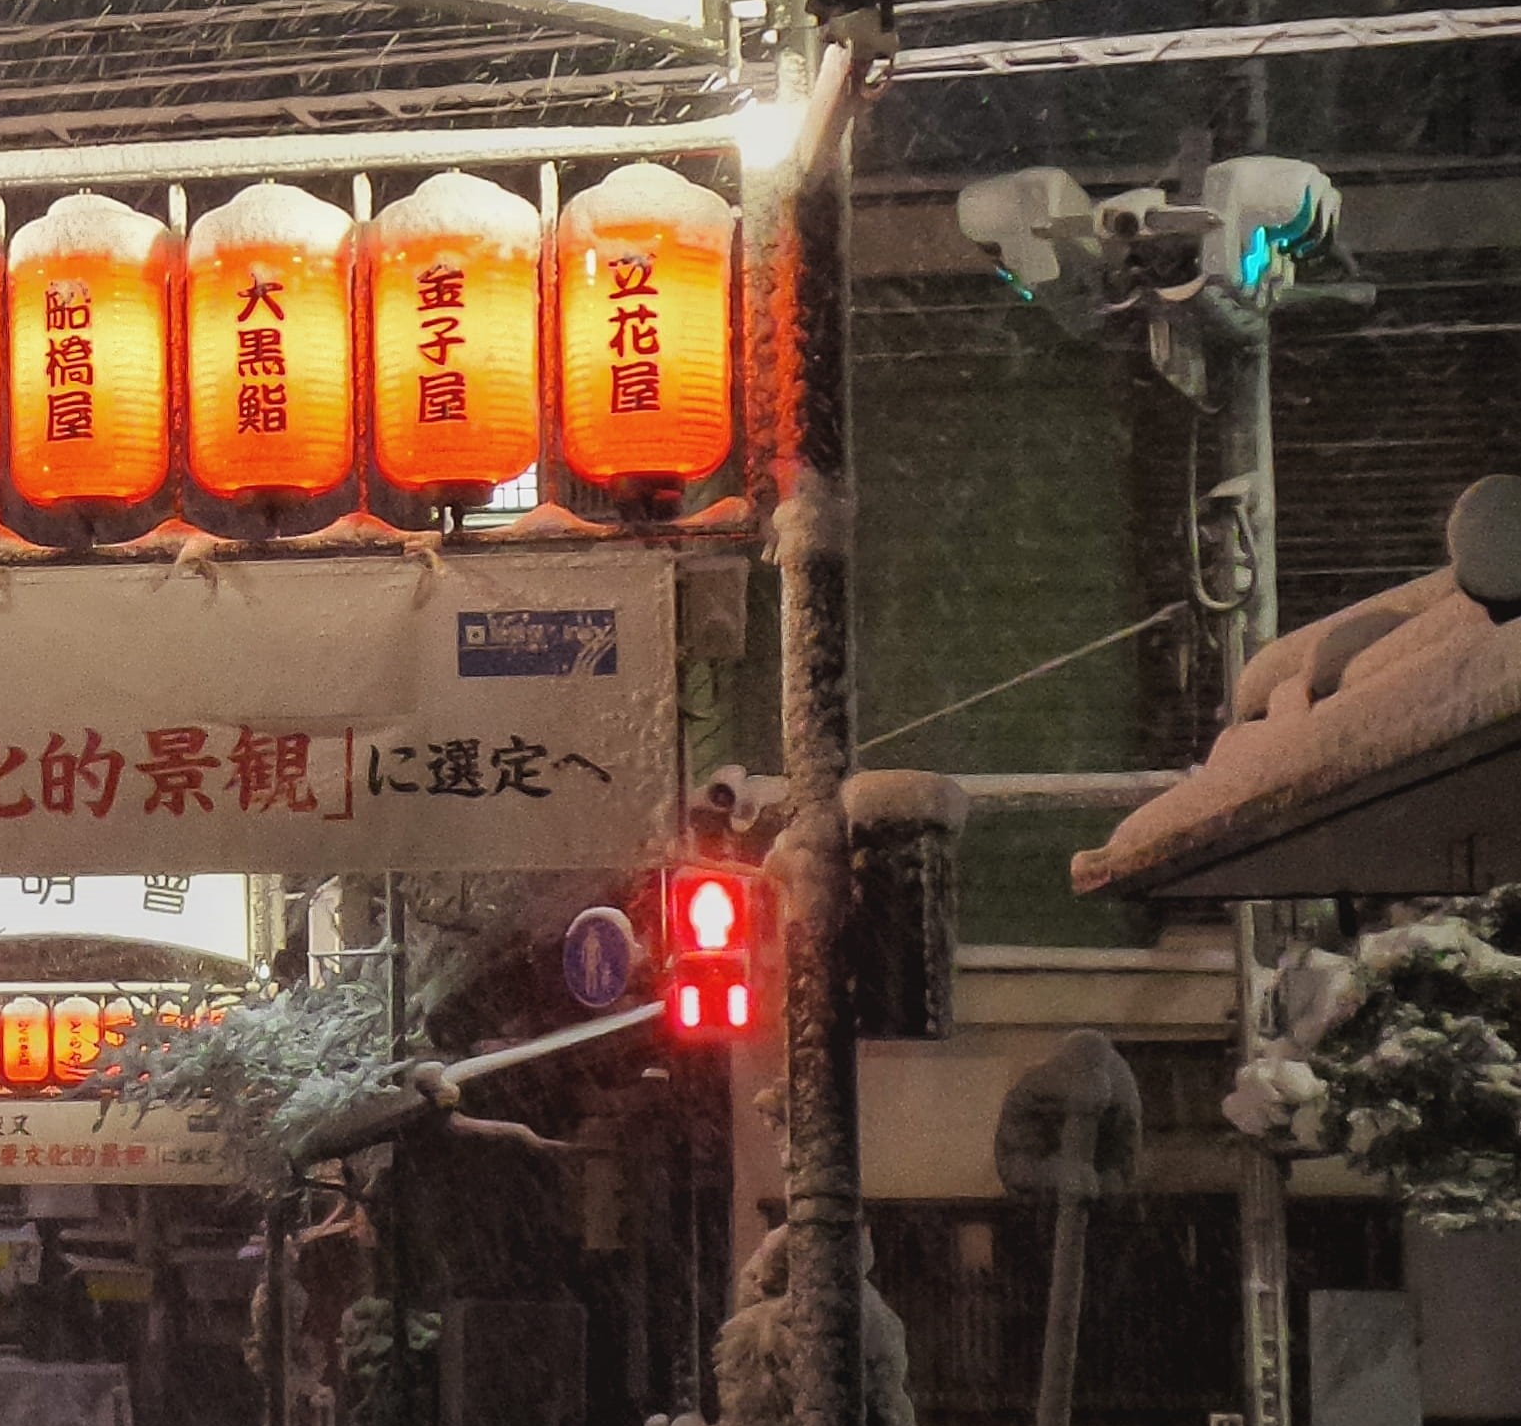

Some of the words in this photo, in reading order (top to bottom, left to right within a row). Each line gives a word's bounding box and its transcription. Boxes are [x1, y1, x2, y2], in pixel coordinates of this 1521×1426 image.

[237, 270, 286, 434] 大黒鮨
[417, 264, 466, 423] 金子屋
[609, 253, 660, 414] 立花屋
